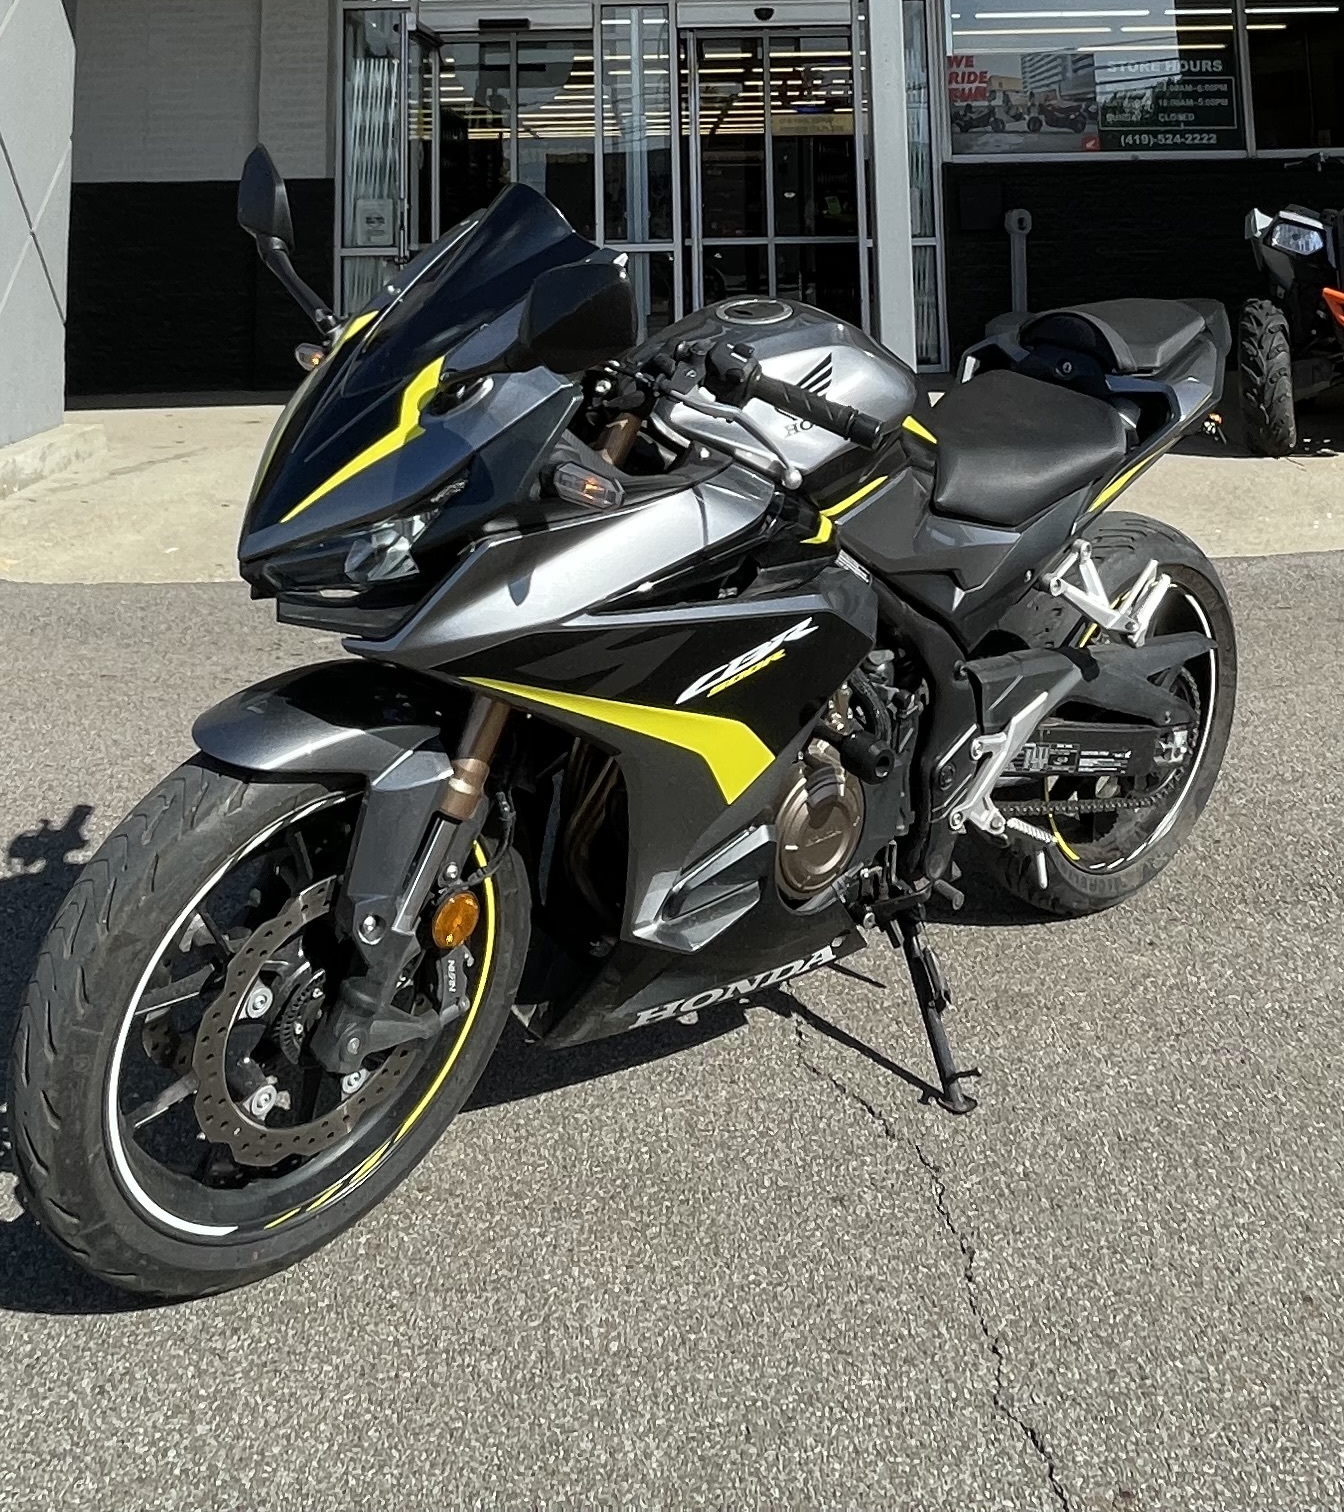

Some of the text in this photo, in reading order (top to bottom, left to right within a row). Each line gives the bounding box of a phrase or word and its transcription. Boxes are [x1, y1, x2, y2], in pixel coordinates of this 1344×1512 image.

[947, 55, 974, 68] WE
[1107, 59, 1223, 72] STORE HOURS
[948, 71, 988, 85] RIDE
[1158, 113, 1195, 122] CLOSED
[1120, 133, 1217, 147] (419)-524-2222
[628, 945, 837, 1029] HONDA
